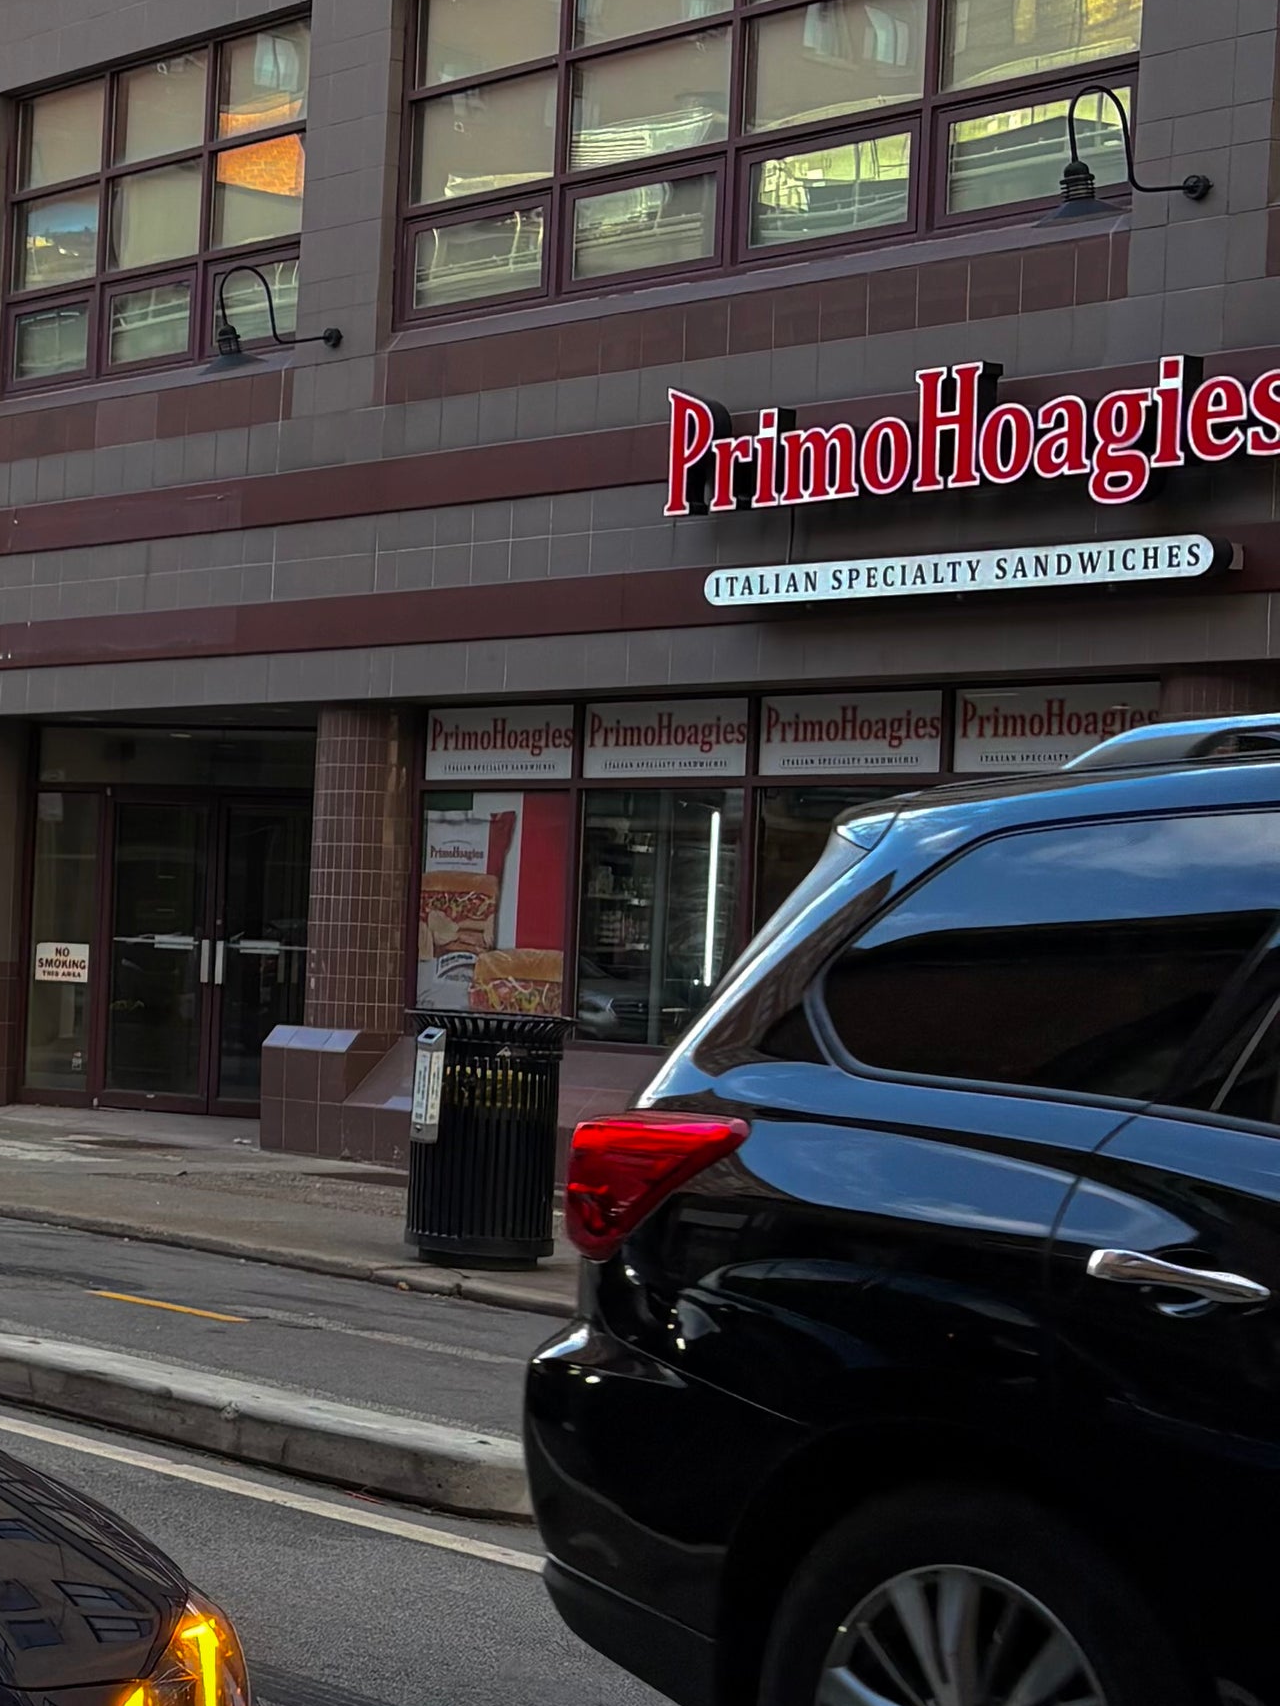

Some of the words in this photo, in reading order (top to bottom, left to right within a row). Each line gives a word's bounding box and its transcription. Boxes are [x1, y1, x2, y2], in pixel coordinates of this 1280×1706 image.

[663, 354, 1280, 516] PrimoHoagies
[714, 570, 819, 597] ITALIAN
[831, 559, 981, 590] SPECIALTY
[995, 543, 1201, 579] SANDWICHES
[431, 716, 574, 757] PrimoHoagies
[588, 711, 748, 753] PrimoHoagies
[766, 704, 940, 748] PrimoHoagies
[38, 958, 86, 970] SMOKING
[55, 947, 70, 957] NO
